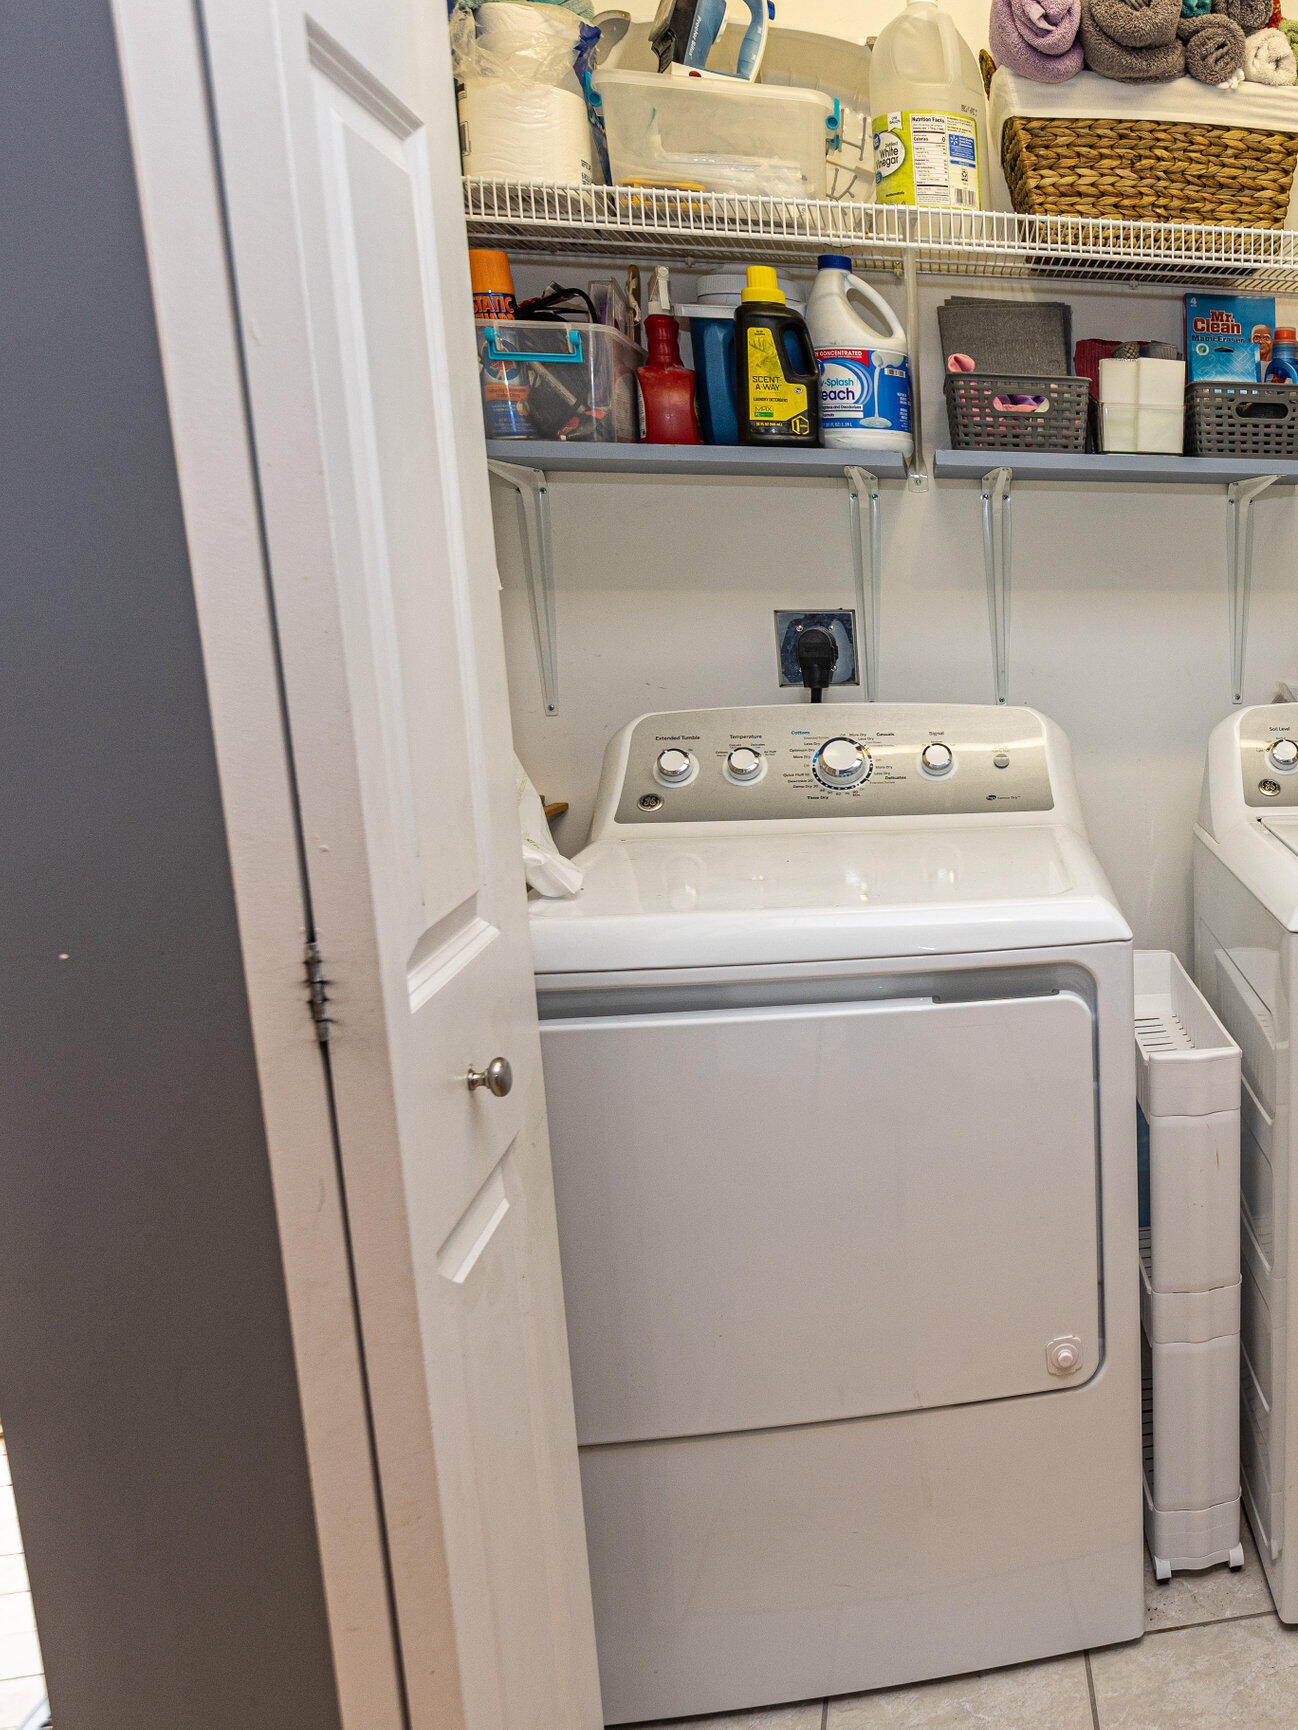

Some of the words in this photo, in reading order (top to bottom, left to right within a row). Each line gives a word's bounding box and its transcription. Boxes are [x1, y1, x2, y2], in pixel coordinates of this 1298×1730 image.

[880, 147, 899, 158] White
[1210, 310, 1235, 322] Mr.
[1193, 317, 1241, 335] Clean
